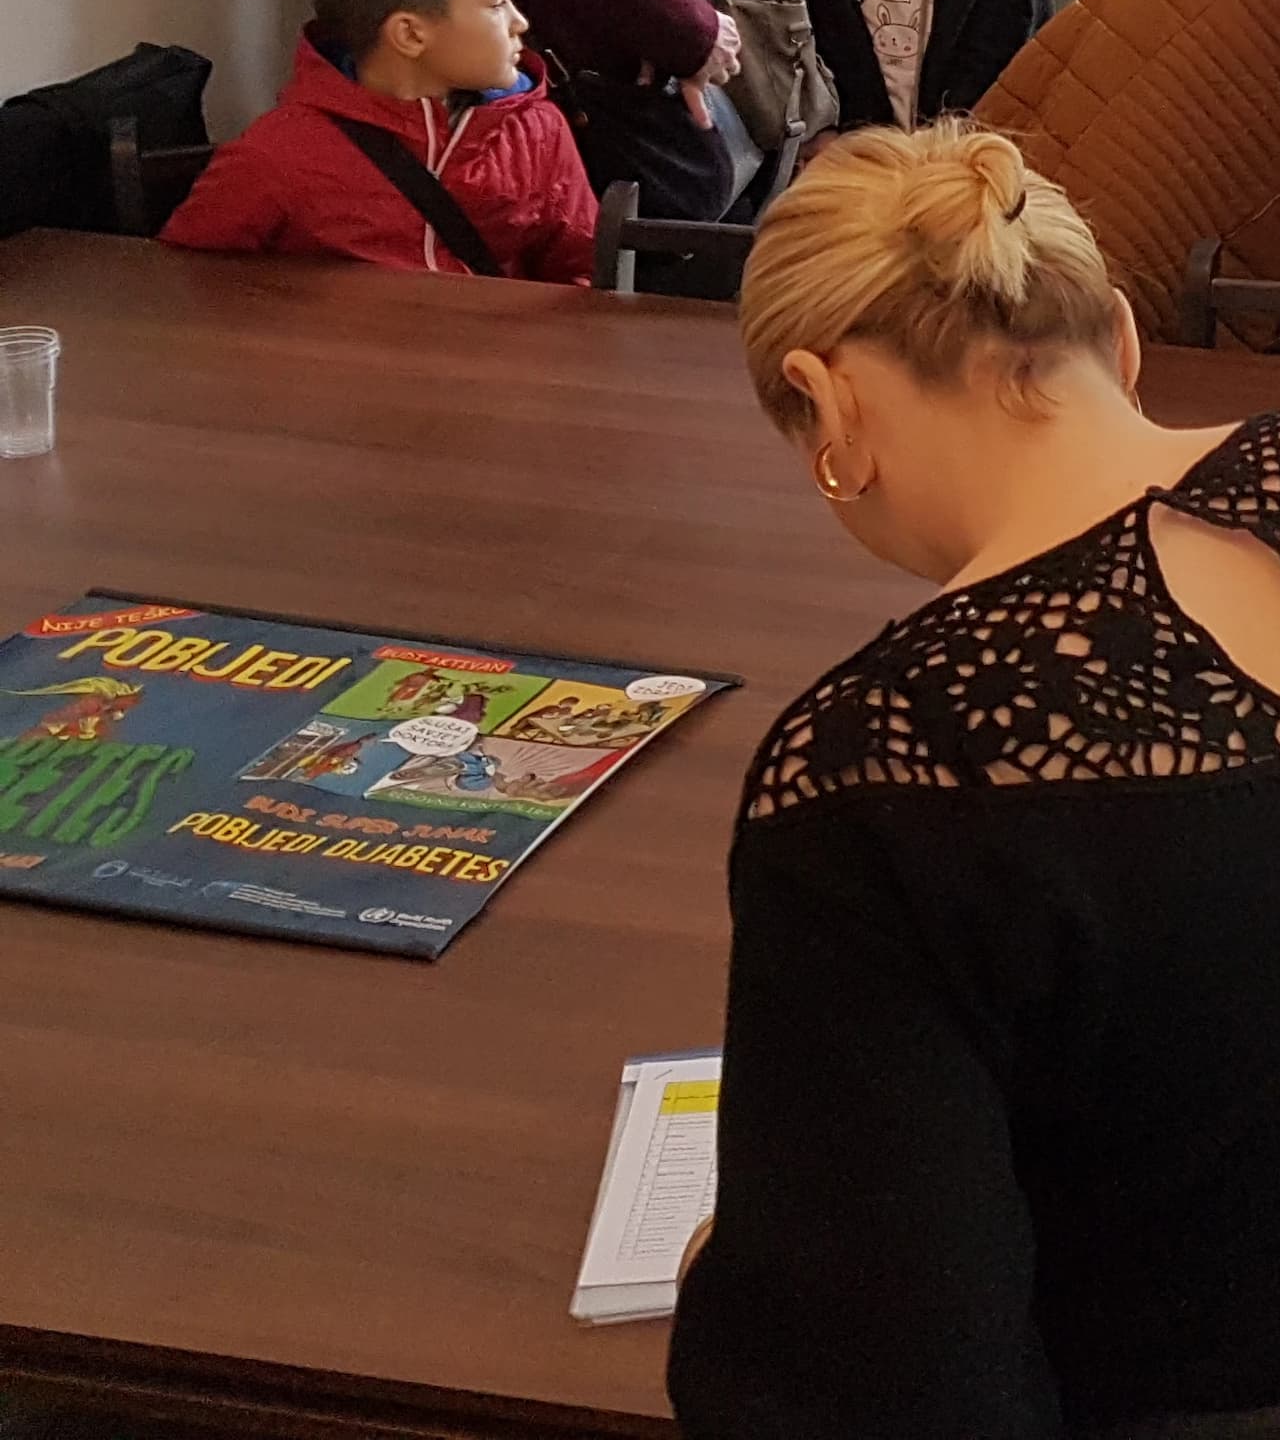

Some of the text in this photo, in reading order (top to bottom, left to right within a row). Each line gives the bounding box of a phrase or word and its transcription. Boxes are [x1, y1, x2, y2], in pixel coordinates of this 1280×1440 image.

[41, 615, 103, 633] NIJE
[58, 627, 352, 690] POBIJEDI
[167, 813, 511, 883] POBIJEDI DIJABETES
